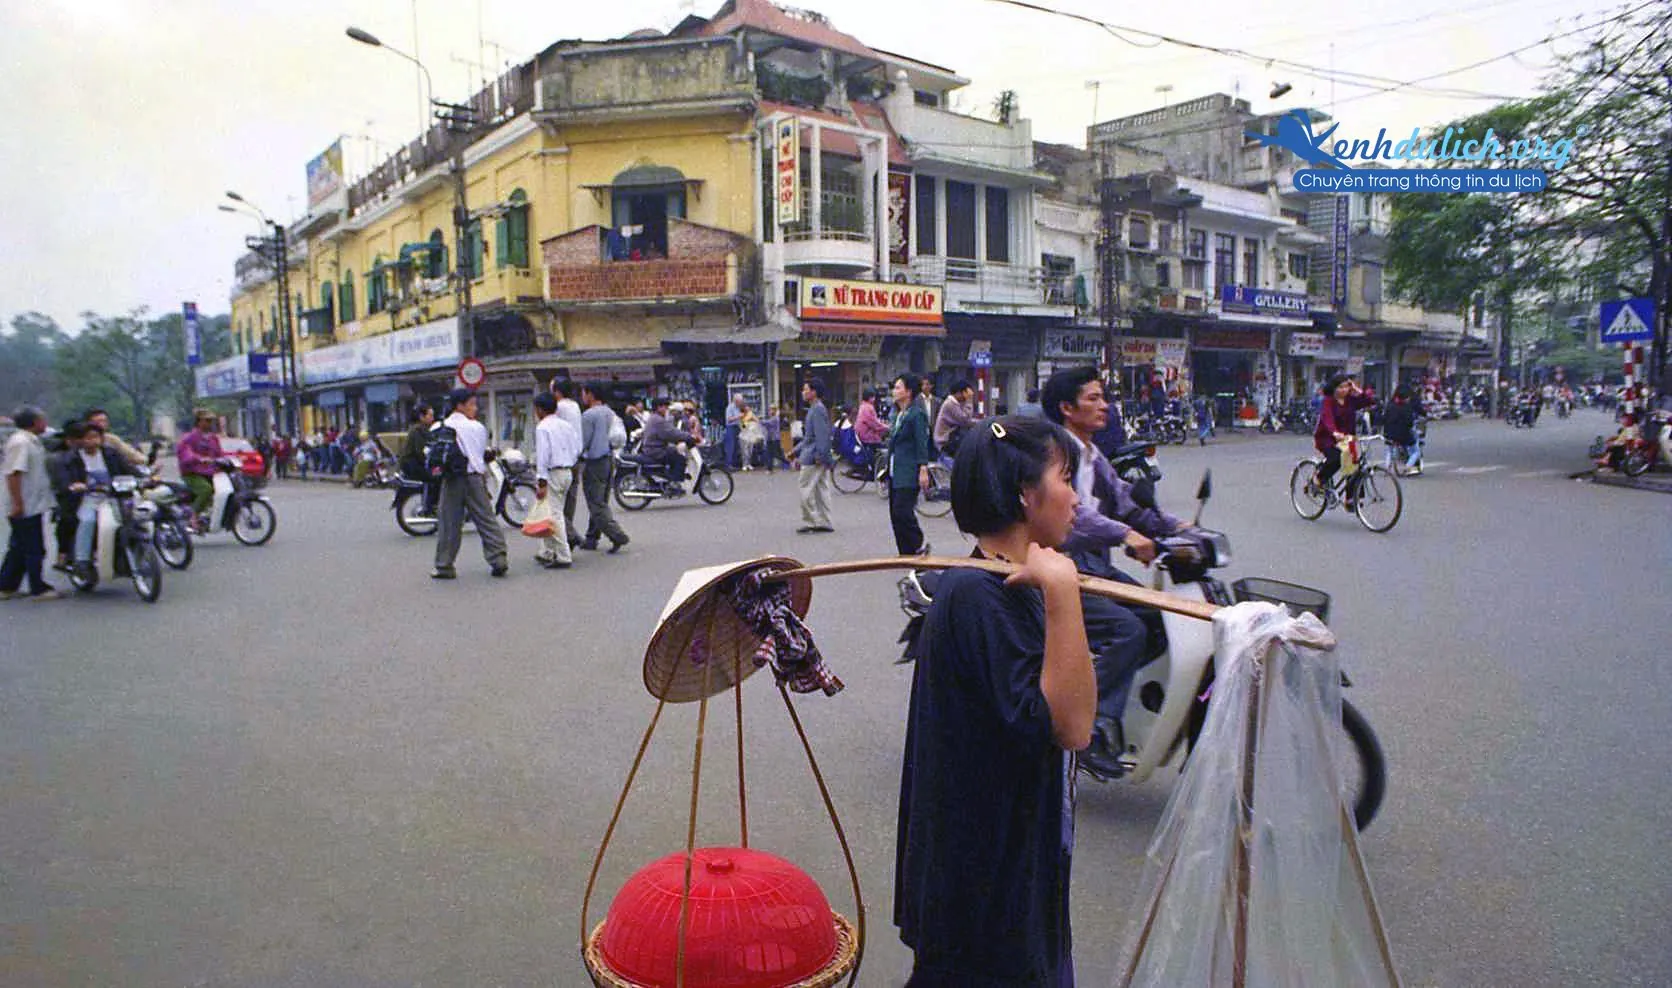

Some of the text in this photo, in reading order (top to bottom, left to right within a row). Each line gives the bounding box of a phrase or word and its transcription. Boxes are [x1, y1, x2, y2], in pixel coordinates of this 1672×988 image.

[851, 288, 889, 307] TRANG
[891, 290, 912, 309] CAO
[1254, 294, 1306, 311] GALLERY
